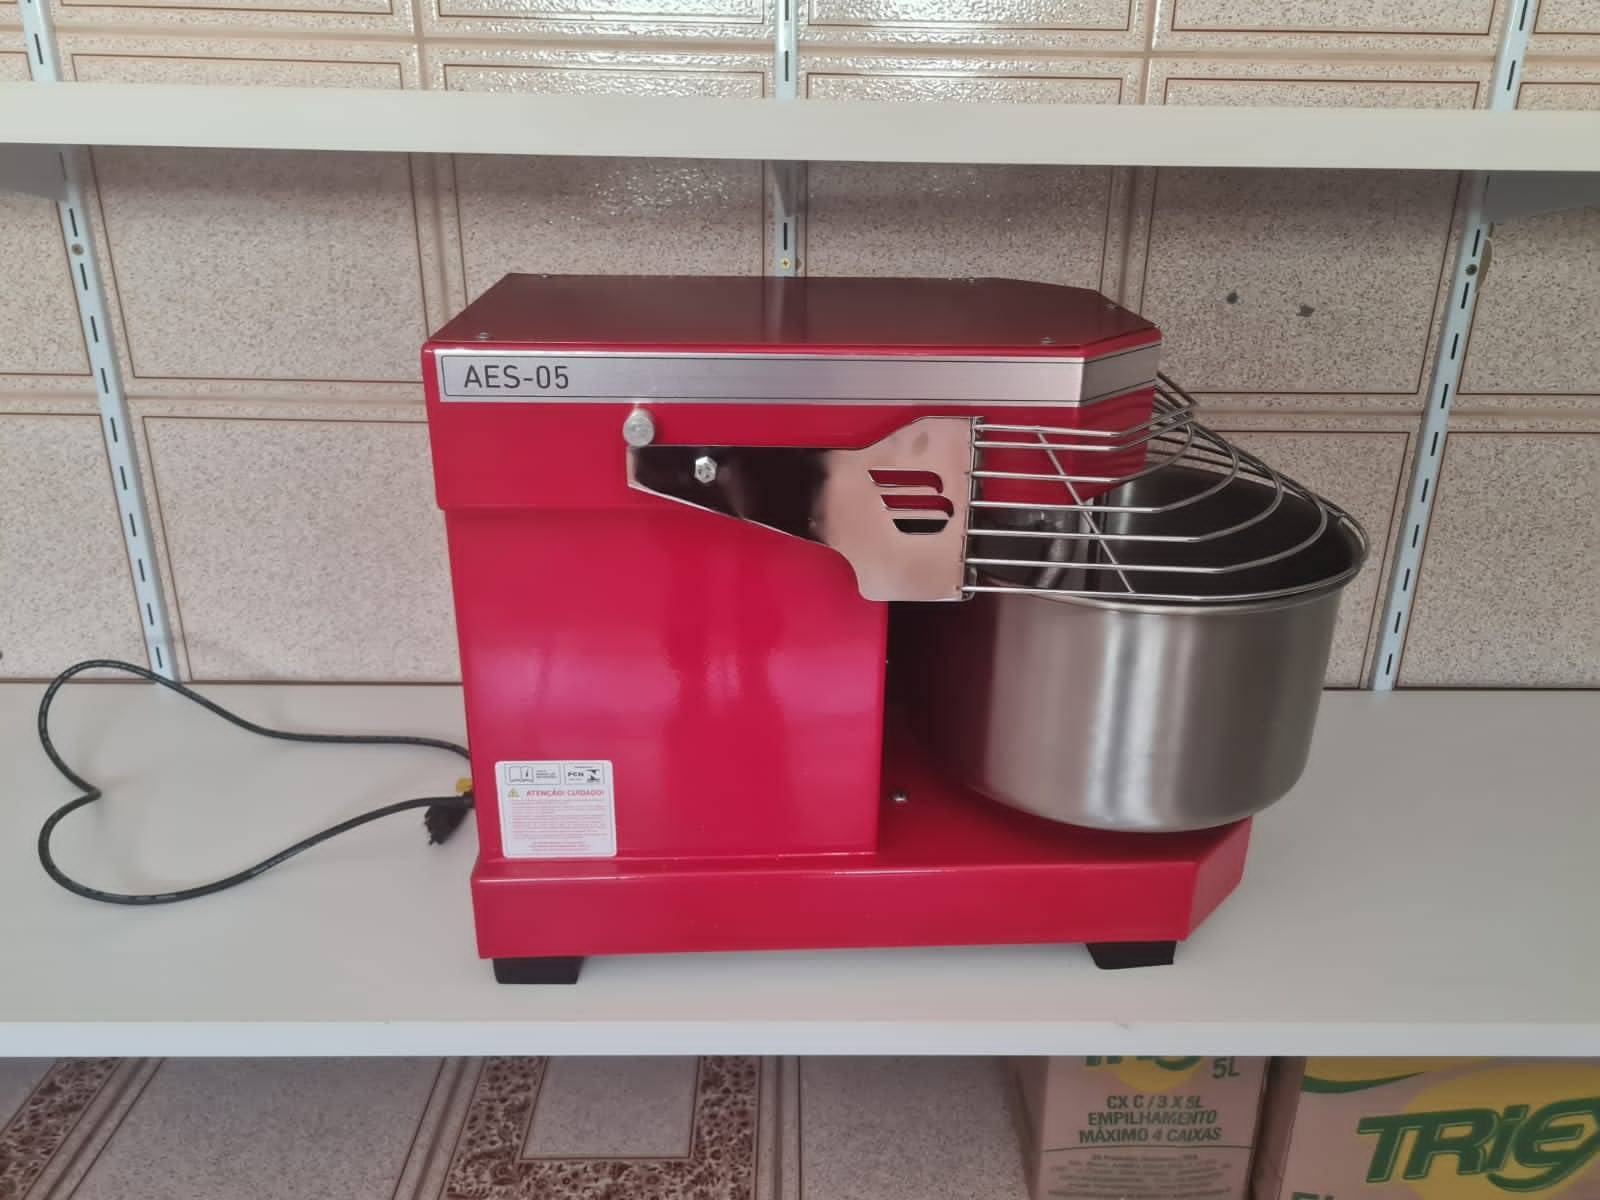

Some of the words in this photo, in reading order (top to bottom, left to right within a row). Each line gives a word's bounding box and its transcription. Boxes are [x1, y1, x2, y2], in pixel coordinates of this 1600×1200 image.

[464, 364, 569, 389] AES-05
[1213, 1056, 1240, 1079] 5L
[1107, 1095, 1128, 1109] CX
[1088, 1110, 1217, 1126] EMPILHAMENTO
[1079, 1127, 1149, 1144] MÁXIMO
[1152, 1129, 1163, 1142] 4
[1167, 1127, 1222, 1142] CAIXAS
